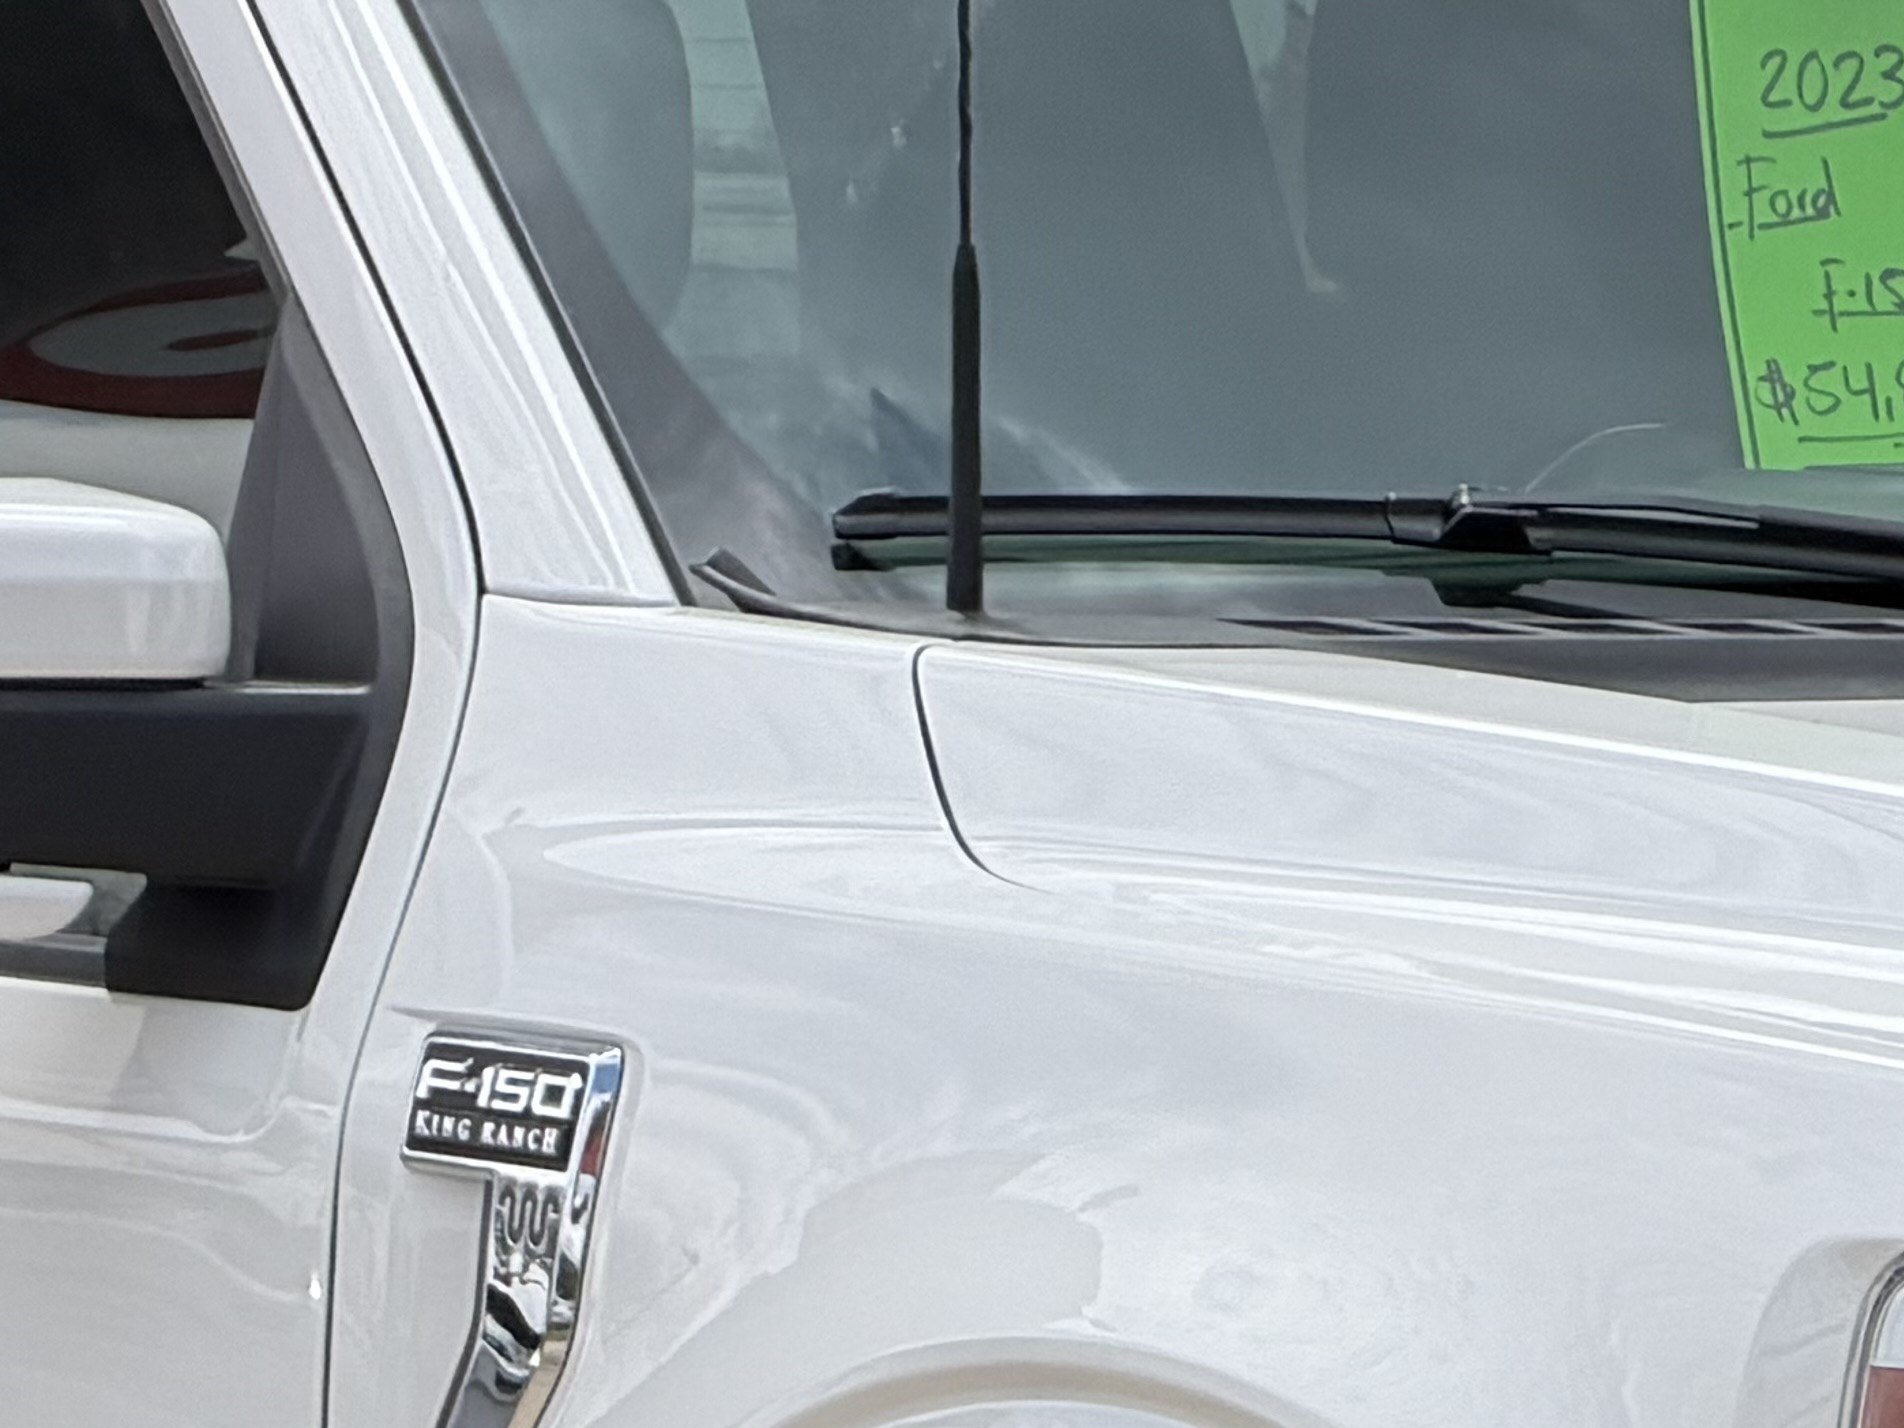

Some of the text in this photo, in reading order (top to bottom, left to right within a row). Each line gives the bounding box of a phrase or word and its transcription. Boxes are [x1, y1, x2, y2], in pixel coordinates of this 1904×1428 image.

[1736, 154, 1842, 241] Ford
[415, 1057, 584, 1120] F-150
[414, 1109, 560, 1155] KING RANCH
